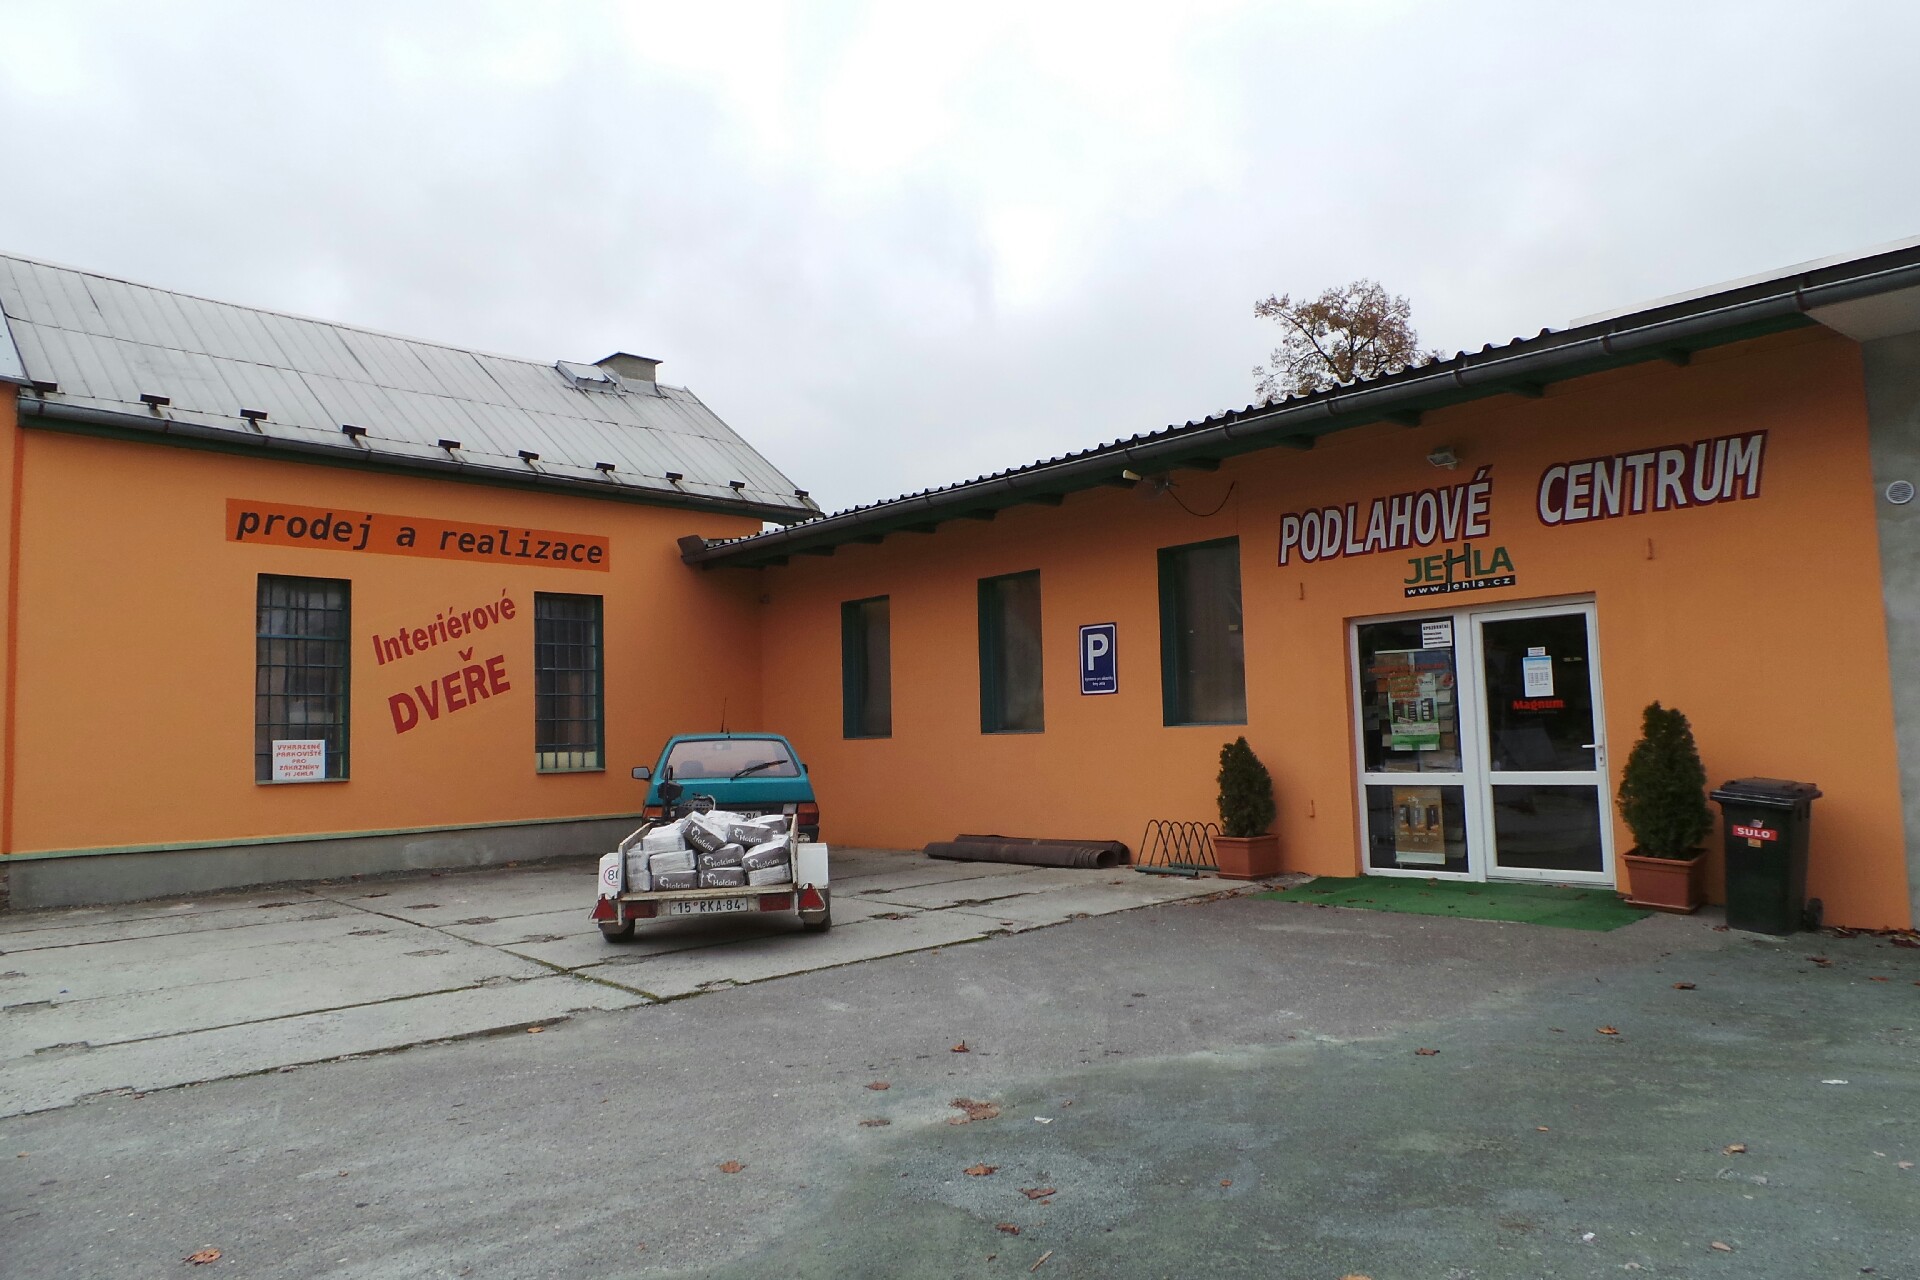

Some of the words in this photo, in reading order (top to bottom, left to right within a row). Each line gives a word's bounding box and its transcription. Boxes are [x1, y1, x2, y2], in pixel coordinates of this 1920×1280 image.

[1279, 466, 1493, 566] PODLAHOVÉ
[1538, 430, 1767, 525] CENTRUM
[236, 511, 373, 550] prodej
[396, 526, 416, 548] a
[439, 530, 603, 564] realizace
[1404, 543, 1514, 584] JEHLA
[1407, 577, 1511, 595] www.jehla.cz
[372, 588, 517, 665] Interiérové
[1088, 634, 1108, 670] P
[388, 647, 511, 734] DVEŘE
[1512, 700, 1565, 710] Magnum
[739, 835, 762, 843] Holcim
[1737, 827, 1770, 838] SULO
[692, 834, 714, 852] Holcim
[710, 858, 735, 868] Holcim
[756, 858, 779, 869] Holcim
